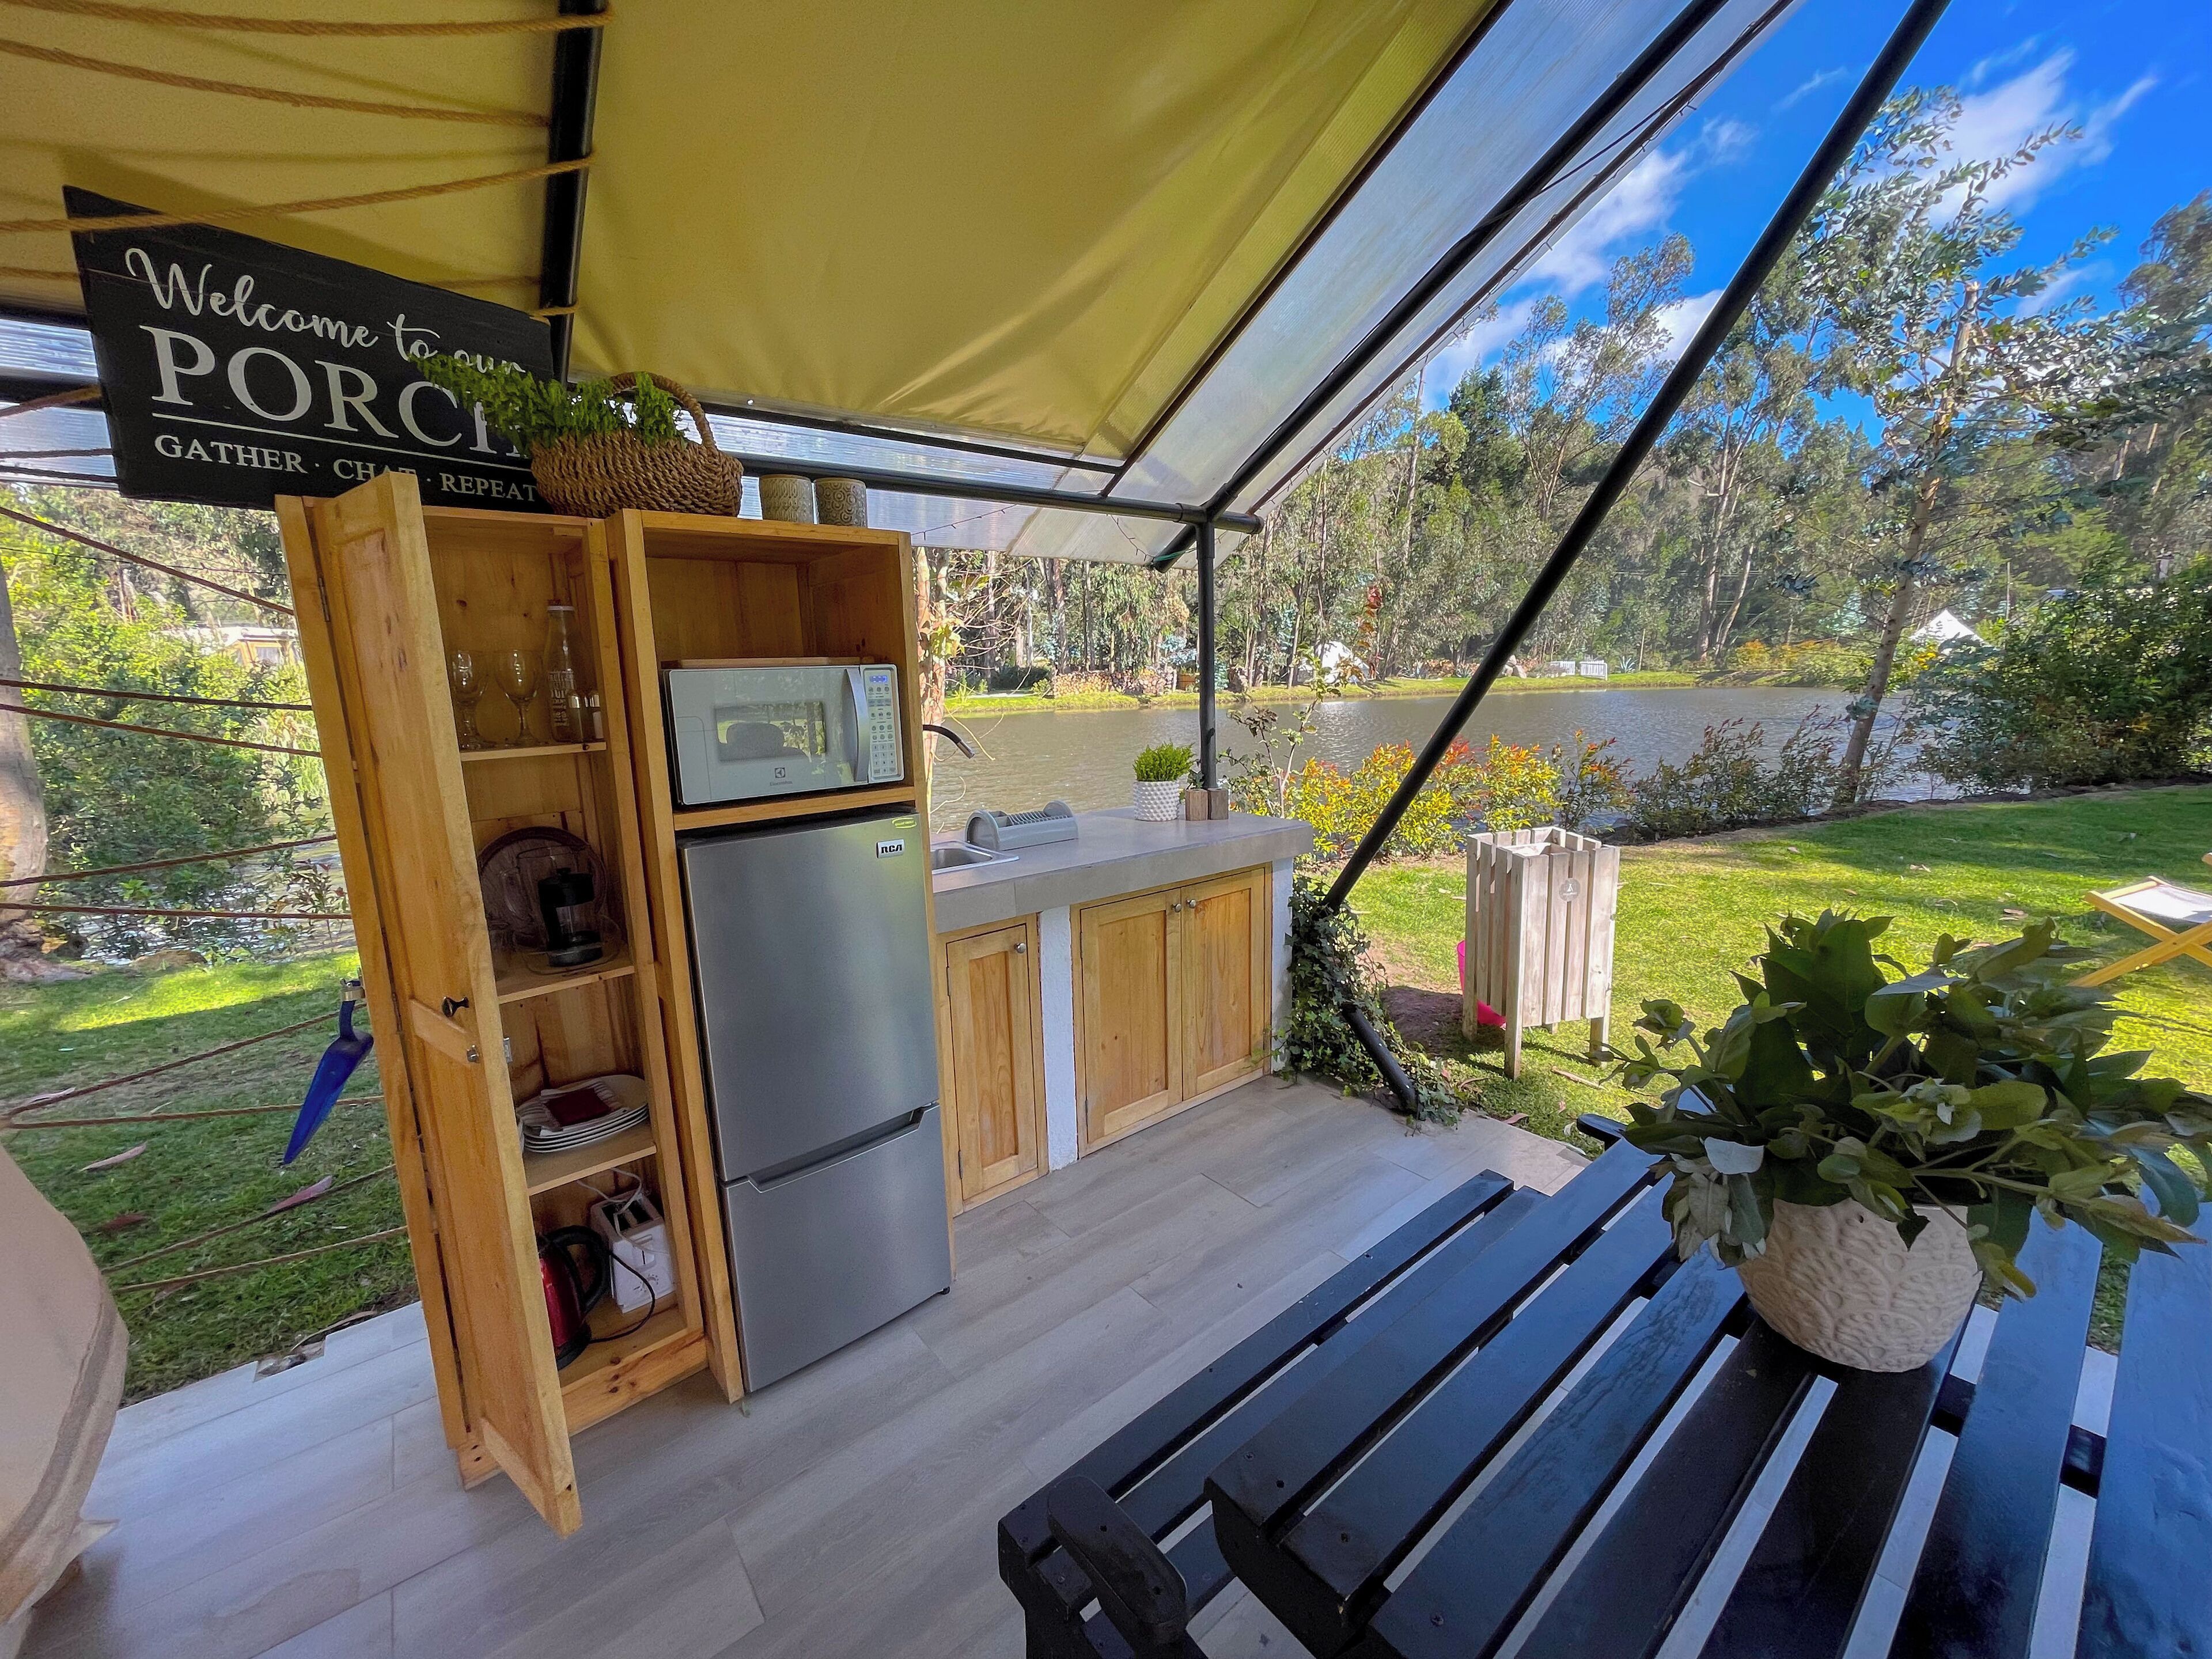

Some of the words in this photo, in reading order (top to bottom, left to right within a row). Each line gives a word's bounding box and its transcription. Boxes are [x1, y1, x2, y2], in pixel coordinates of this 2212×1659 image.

[124, 248, 379, 348] Welcome
[386, 313, 441, 362] to
[453, 349, 526, 375] our
[154, 435, 309, 474] GATHER
[439, 472, 537, 502] REPEAT
[881, 844, 903, 854] RCA
